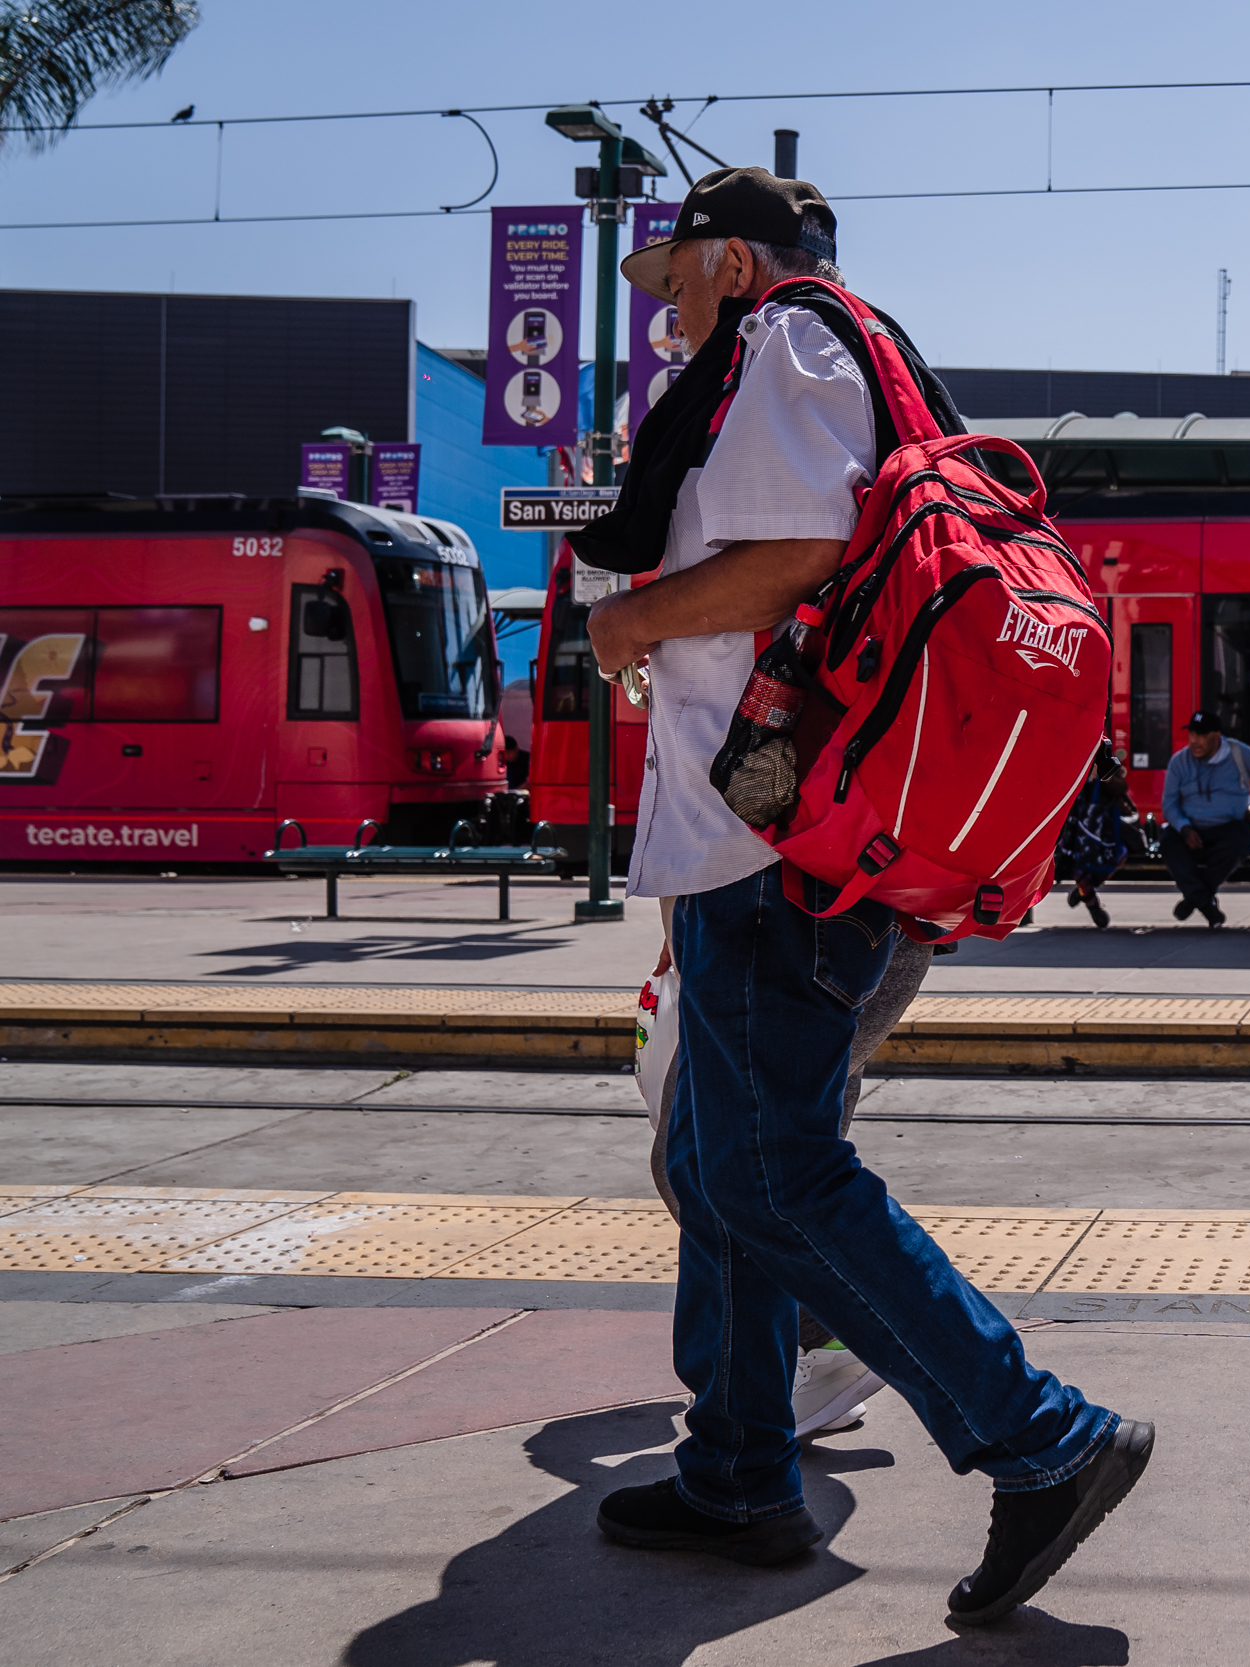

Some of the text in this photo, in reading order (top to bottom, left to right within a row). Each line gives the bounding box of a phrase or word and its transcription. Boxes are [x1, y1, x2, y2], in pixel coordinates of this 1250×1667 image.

[507, 223, 568, 235] PRONTO
[506, 240, 569, 250] EVERY RIDE,
[506, 252, 569, 261] EVERY TIME.
[509, 264, 565, 273] You must tap
[503, 282, 569, 290] validator before
[514, 291, 558, 302] you board.
[509, 501, 545, 520] San
[232, 538, 284, 556] 5032
[996, 601, 1088, 674] EVERLAST
[26, 823, 199, 847] tecate.travel
